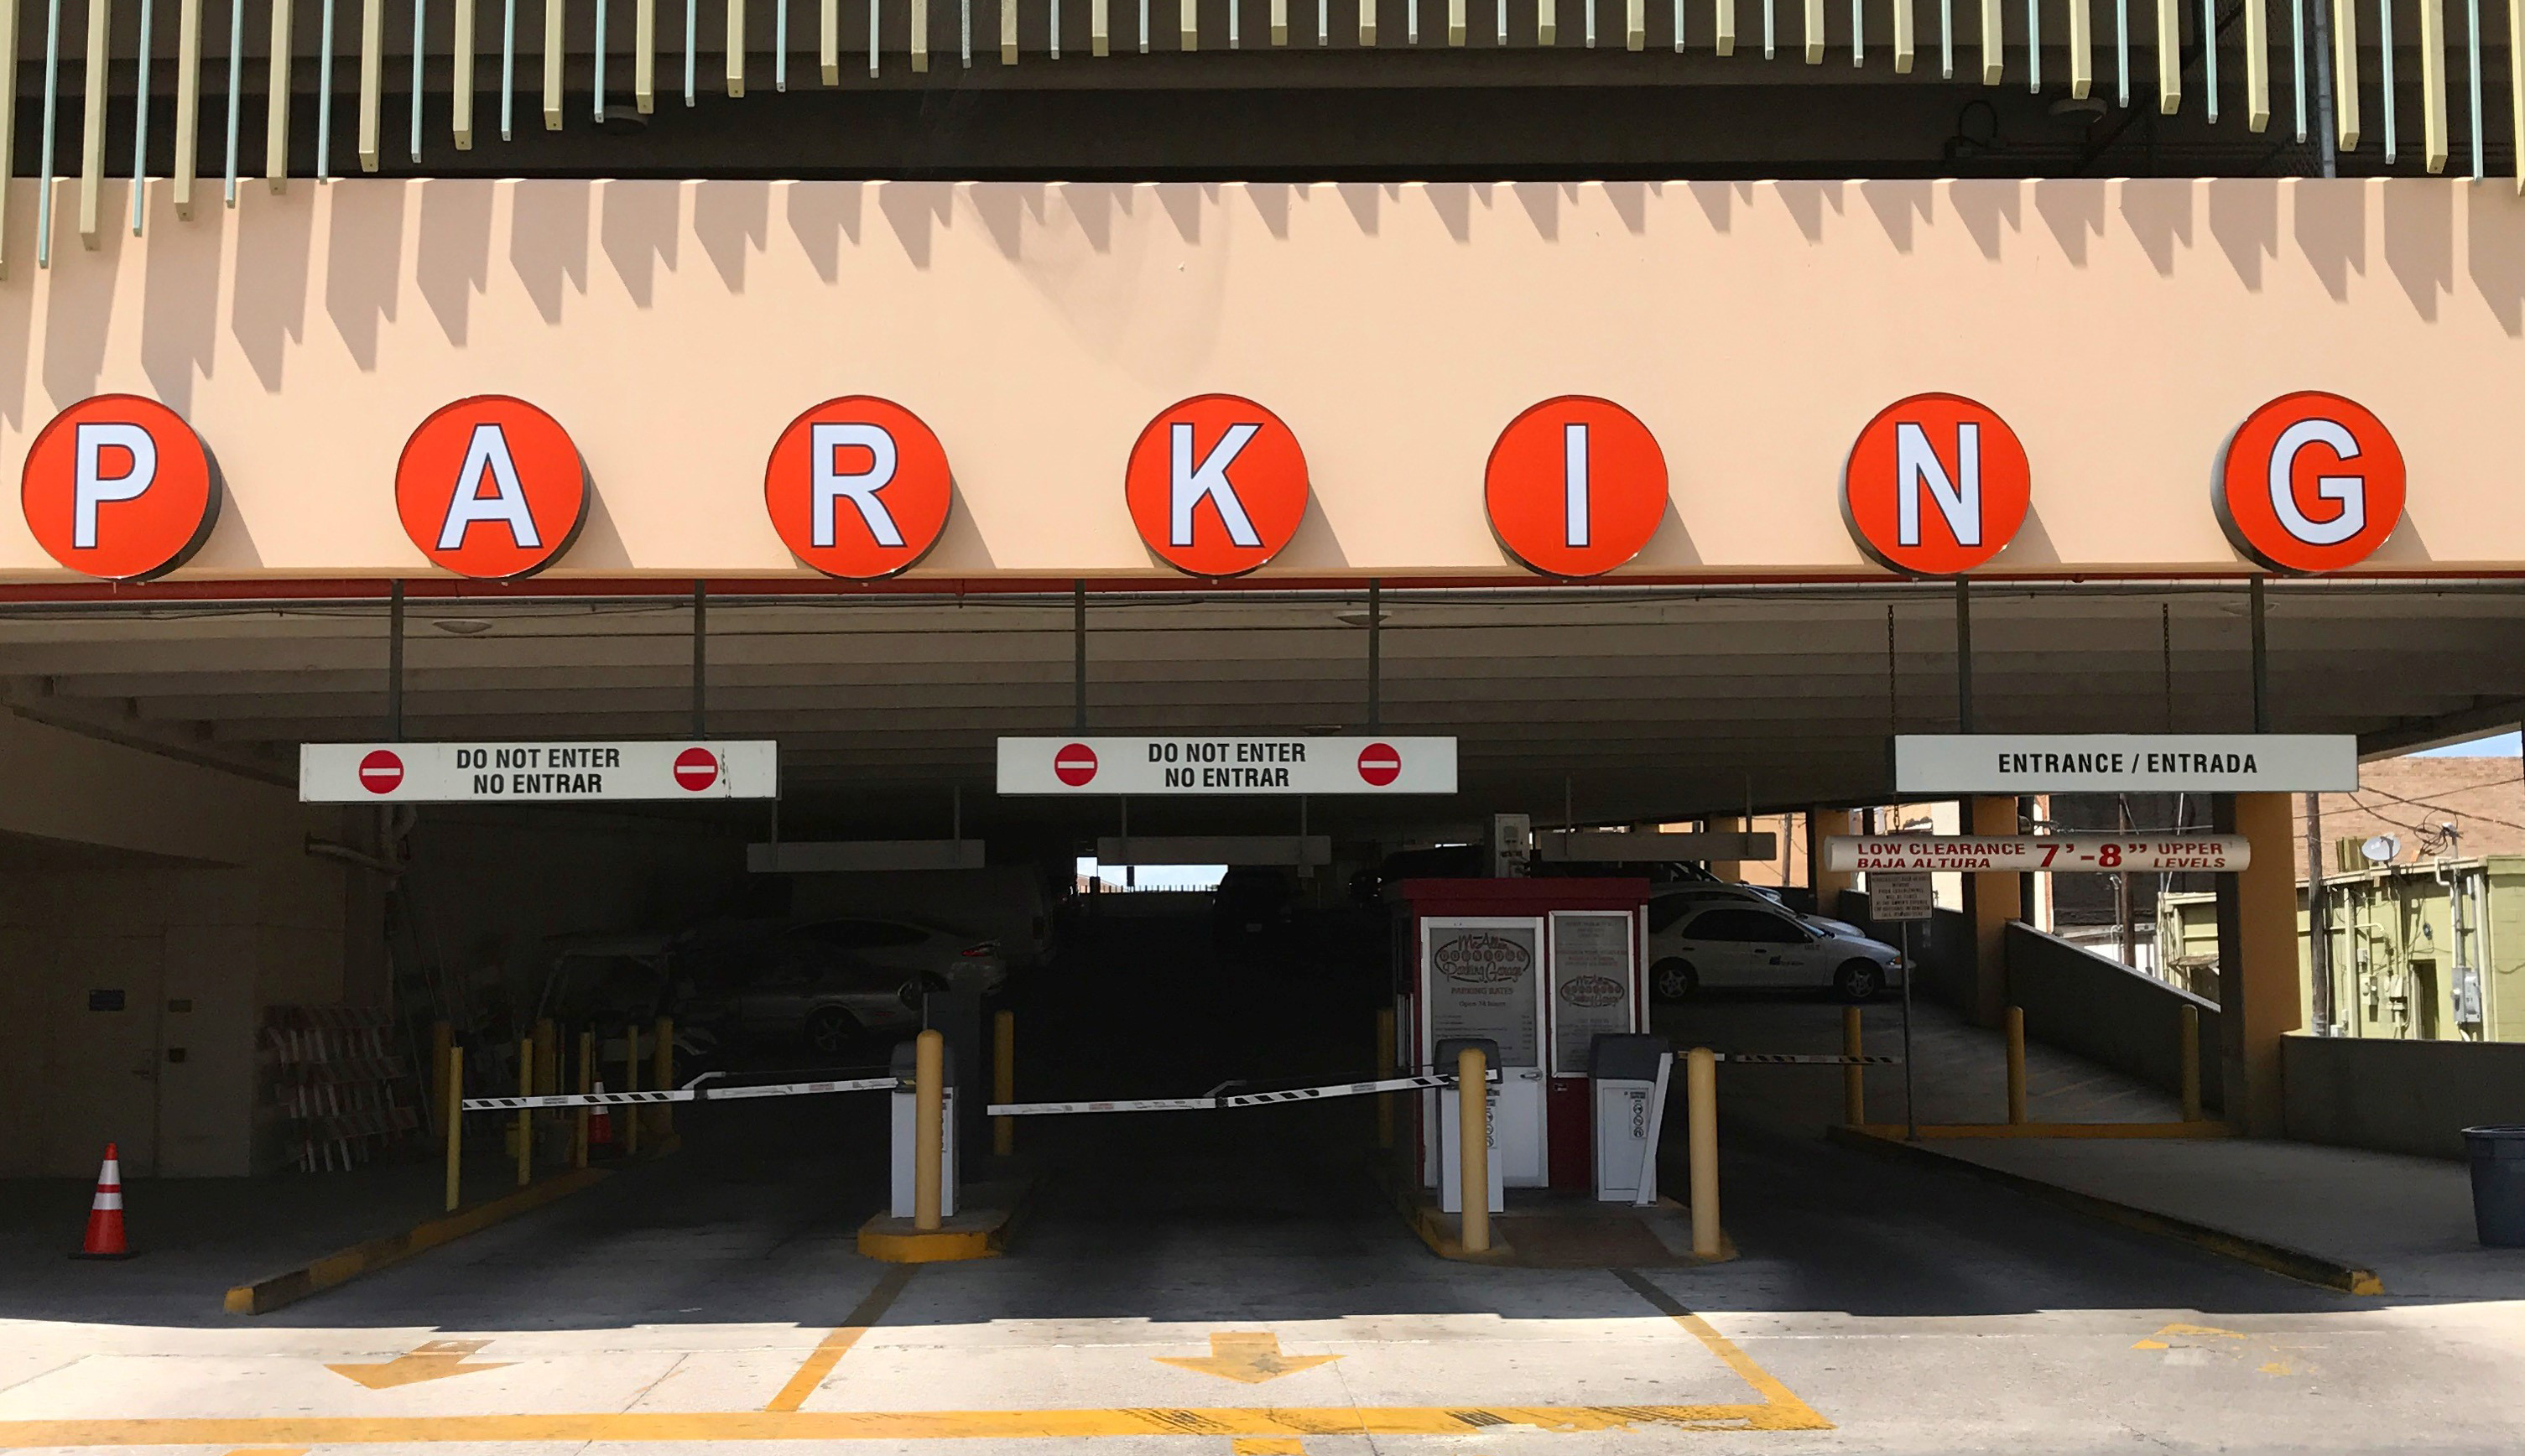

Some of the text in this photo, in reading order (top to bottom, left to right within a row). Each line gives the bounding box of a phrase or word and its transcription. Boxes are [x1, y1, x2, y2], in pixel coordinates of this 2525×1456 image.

[76, 421, 2363, 548] PARKING
[457, 749, 619, 768] DO NOT ENTER
[1149, 743, 1305, 762] DO NOT ENTER
[1999, 754, 2122, 772] ENTRANCE
[2148, 754, 2257, 772] ENTRADA
[475, 774, 601, 793] NO ENTRAR
[1166, 768, 1289, 787] NO ENTRAR
[1857, 843, 2025, 855] LOW CLEARANCE
[2158, 843, 2222, 855] UPPER
[1857, 858, 1991, 868] BAJA ALTURA
[2153, 858, 2226, 868] LEVELS
[1443, 962, 1484, 982] Parking
